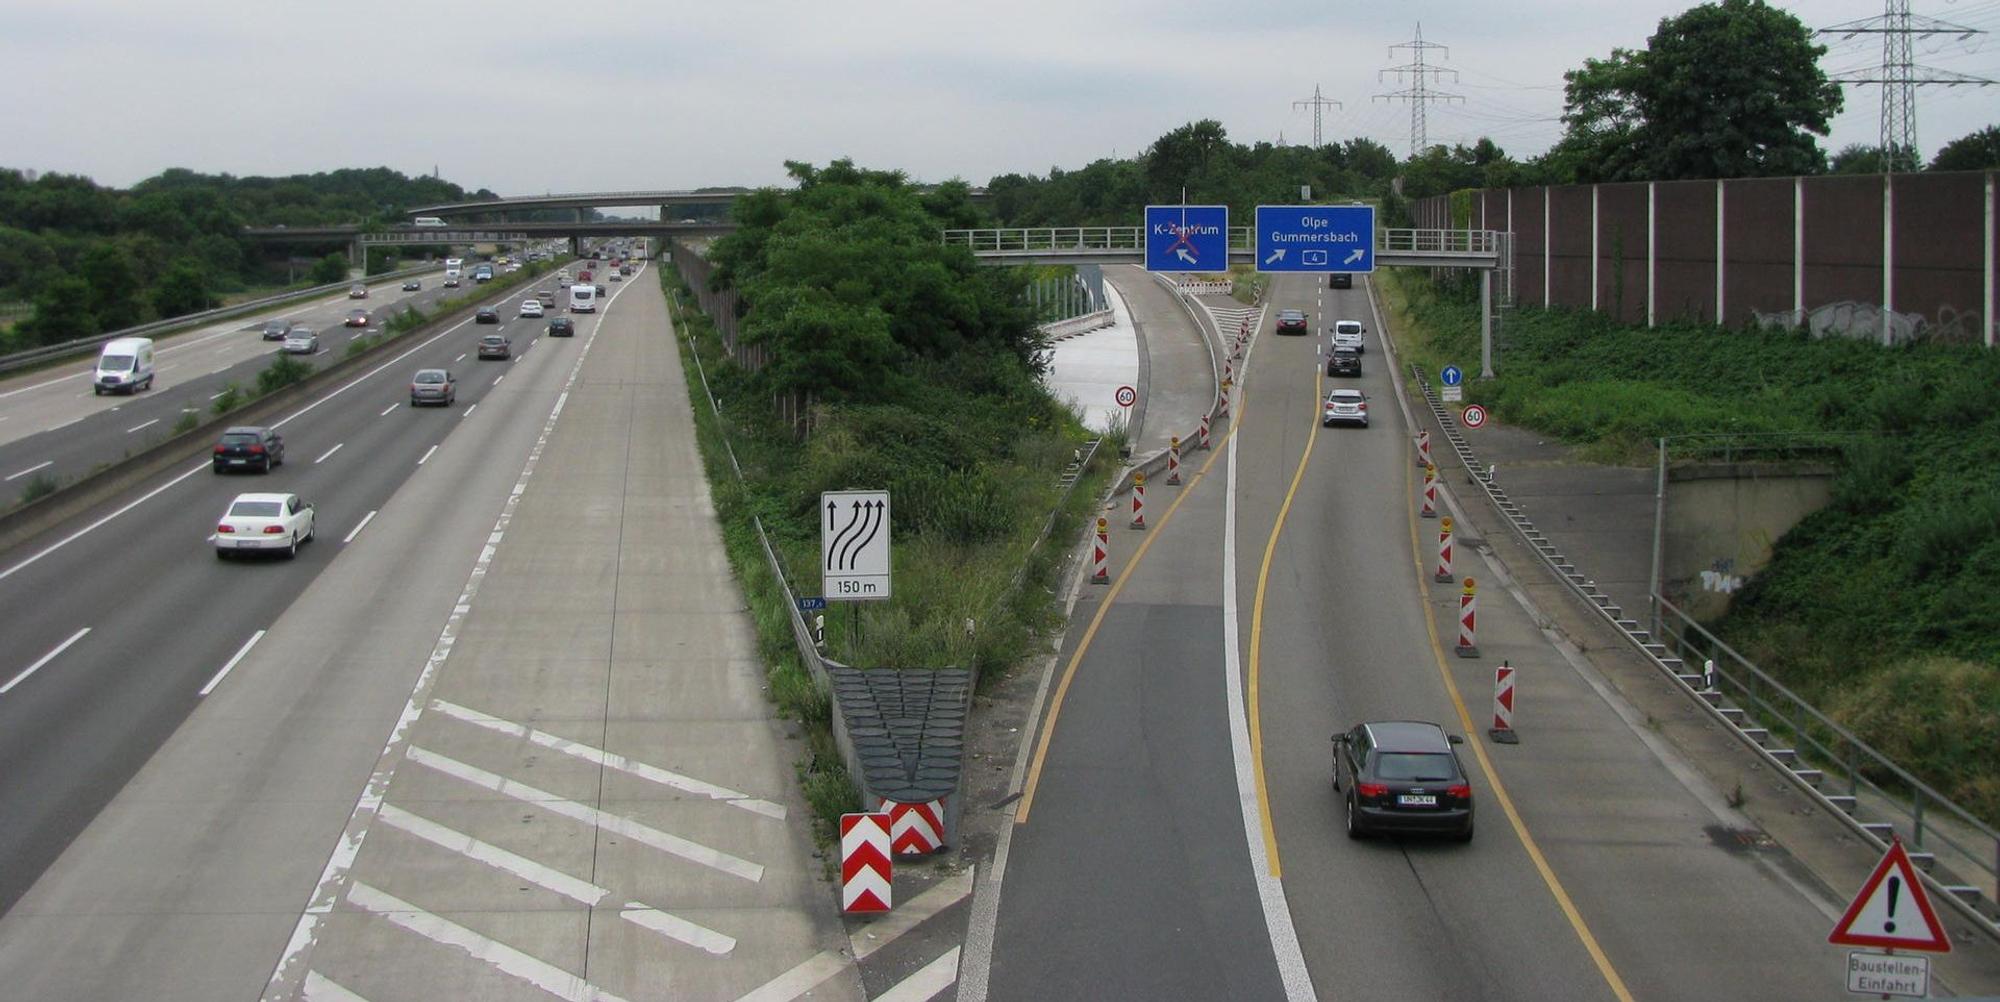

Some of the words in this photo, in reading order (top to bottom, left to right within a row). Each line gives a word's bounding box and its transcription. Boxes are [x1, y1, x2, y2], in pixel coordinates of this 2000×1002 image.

[1301, 216, 1328, 230] Olpe
[1154, 224, 1219, 235] K-Zentrum
[1271, 231, 1358, 242] Gummersbach
[1312, 253, 1318, 262] 4
[1120, 391, 1131, 401] 60
[1467, 410, 1480, 421] 60
[838, 581, 860, 593] 150
[864, 583, 876, 593] m
[1851, 959, 1925, 975] Baustellen-
[1859, 976, 1917, 993] Einfahrt
